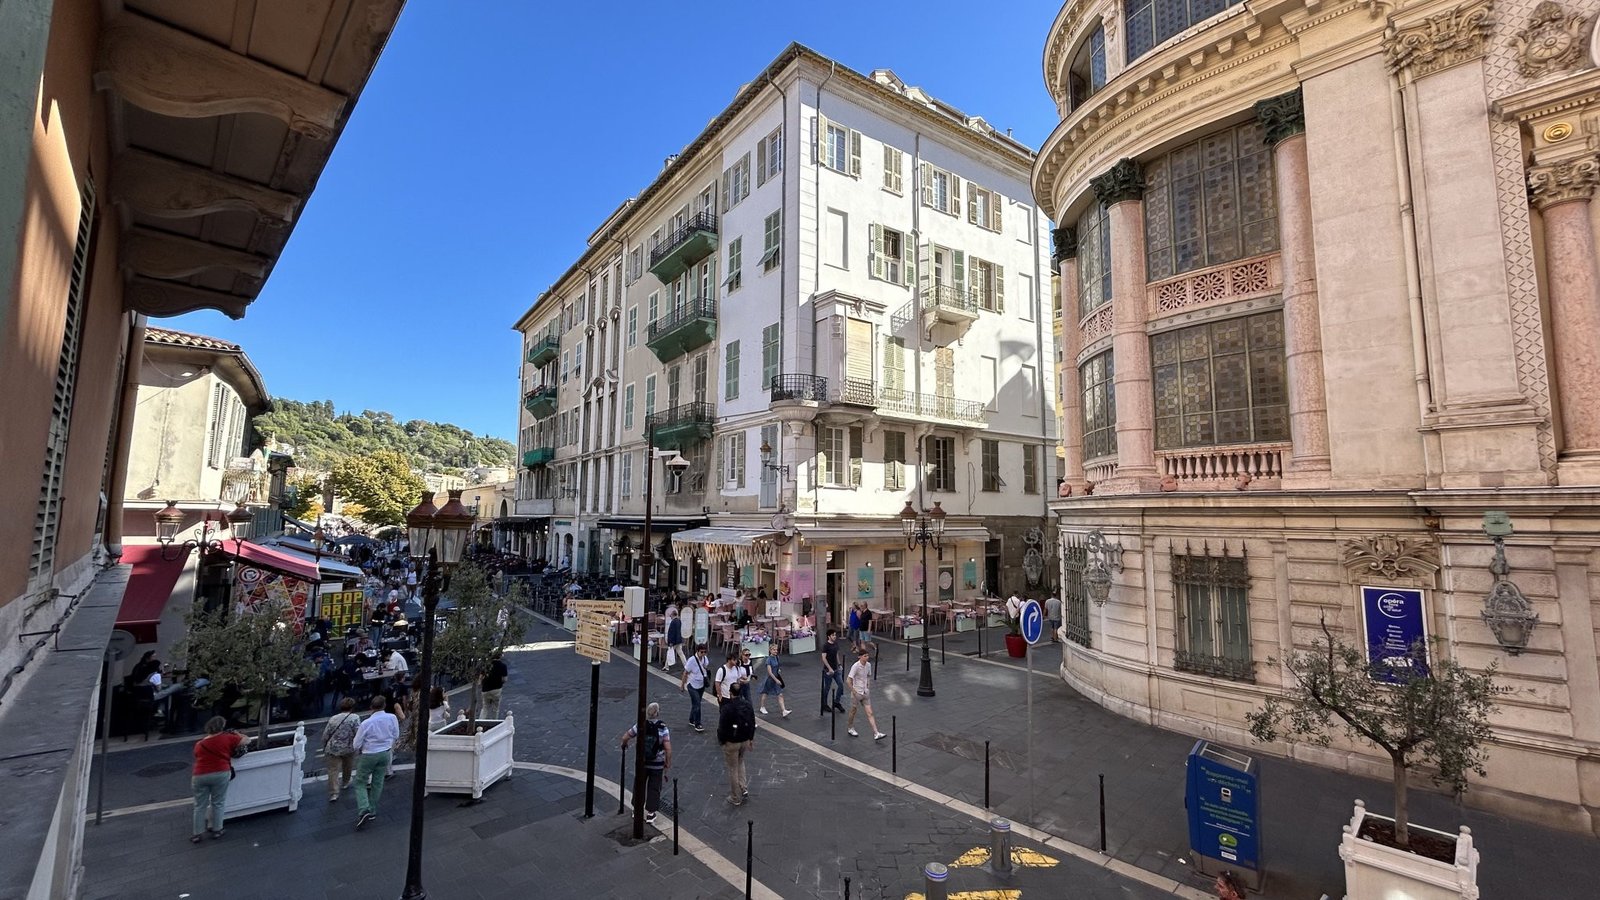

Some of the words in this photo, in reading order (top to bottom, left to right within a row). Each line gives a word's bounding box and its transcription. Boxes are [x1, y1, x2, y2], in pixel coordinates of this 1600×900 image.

[333, 592, 362, 604] POP
[322, 604, 351, 615] ART
[332, 615, 361, 626] TEE
